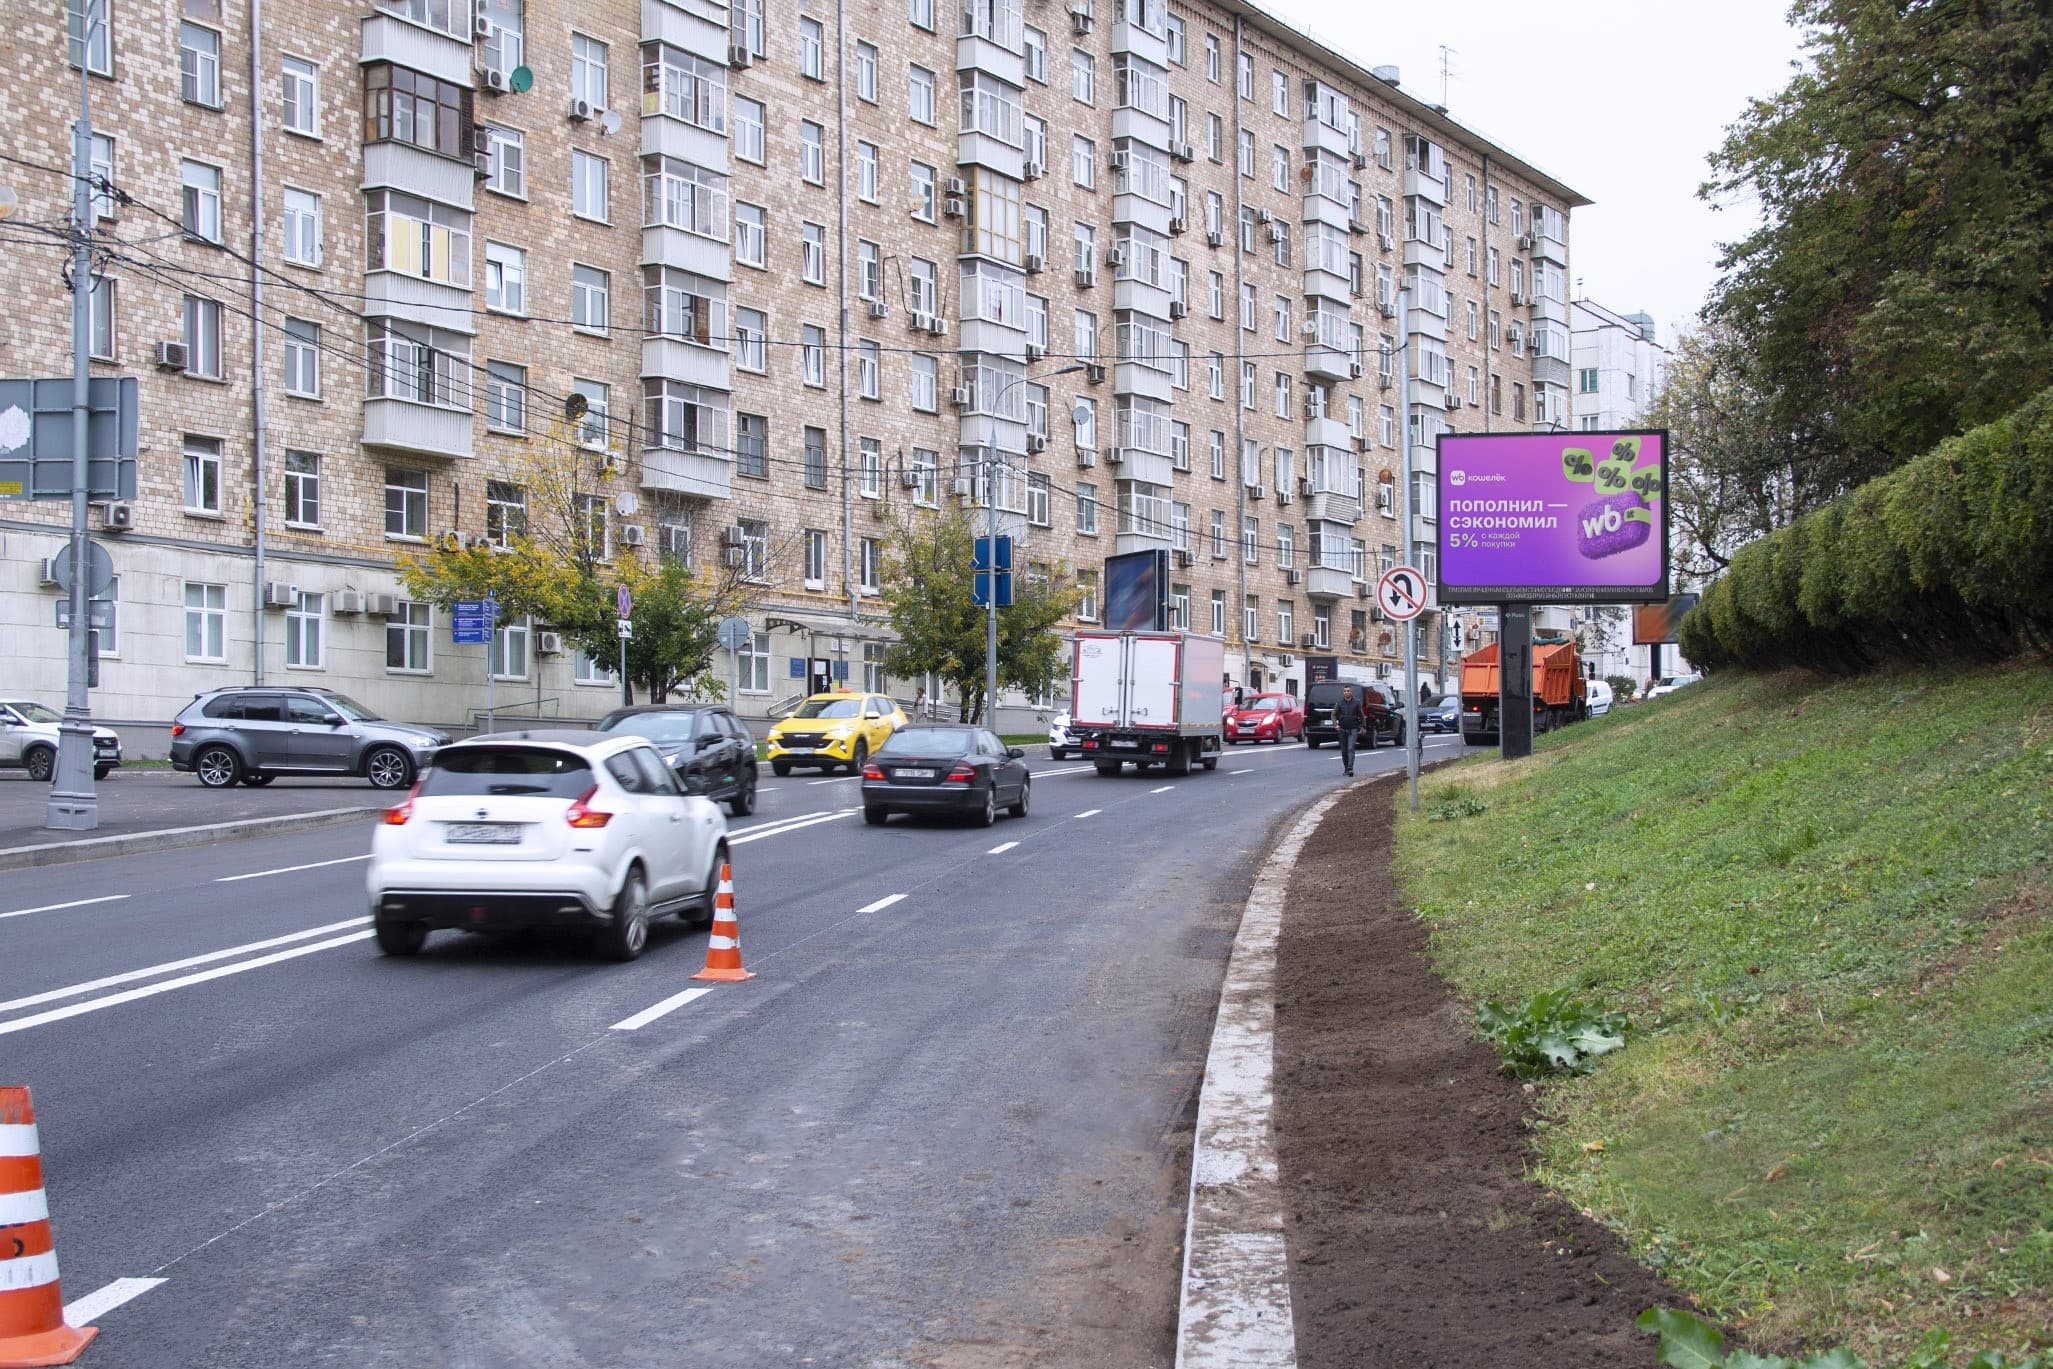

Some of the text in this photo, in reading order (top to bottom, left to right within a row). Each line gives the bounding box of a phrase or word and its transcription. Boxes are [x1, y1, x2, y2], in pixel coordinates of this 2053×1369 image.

[1582, 504, 1621, 538] wb
[1449, 533, 1479, 548] 5%
[1488, 532, 1521, 541] каждой
[1481, 541, 1516, 549] покупки
